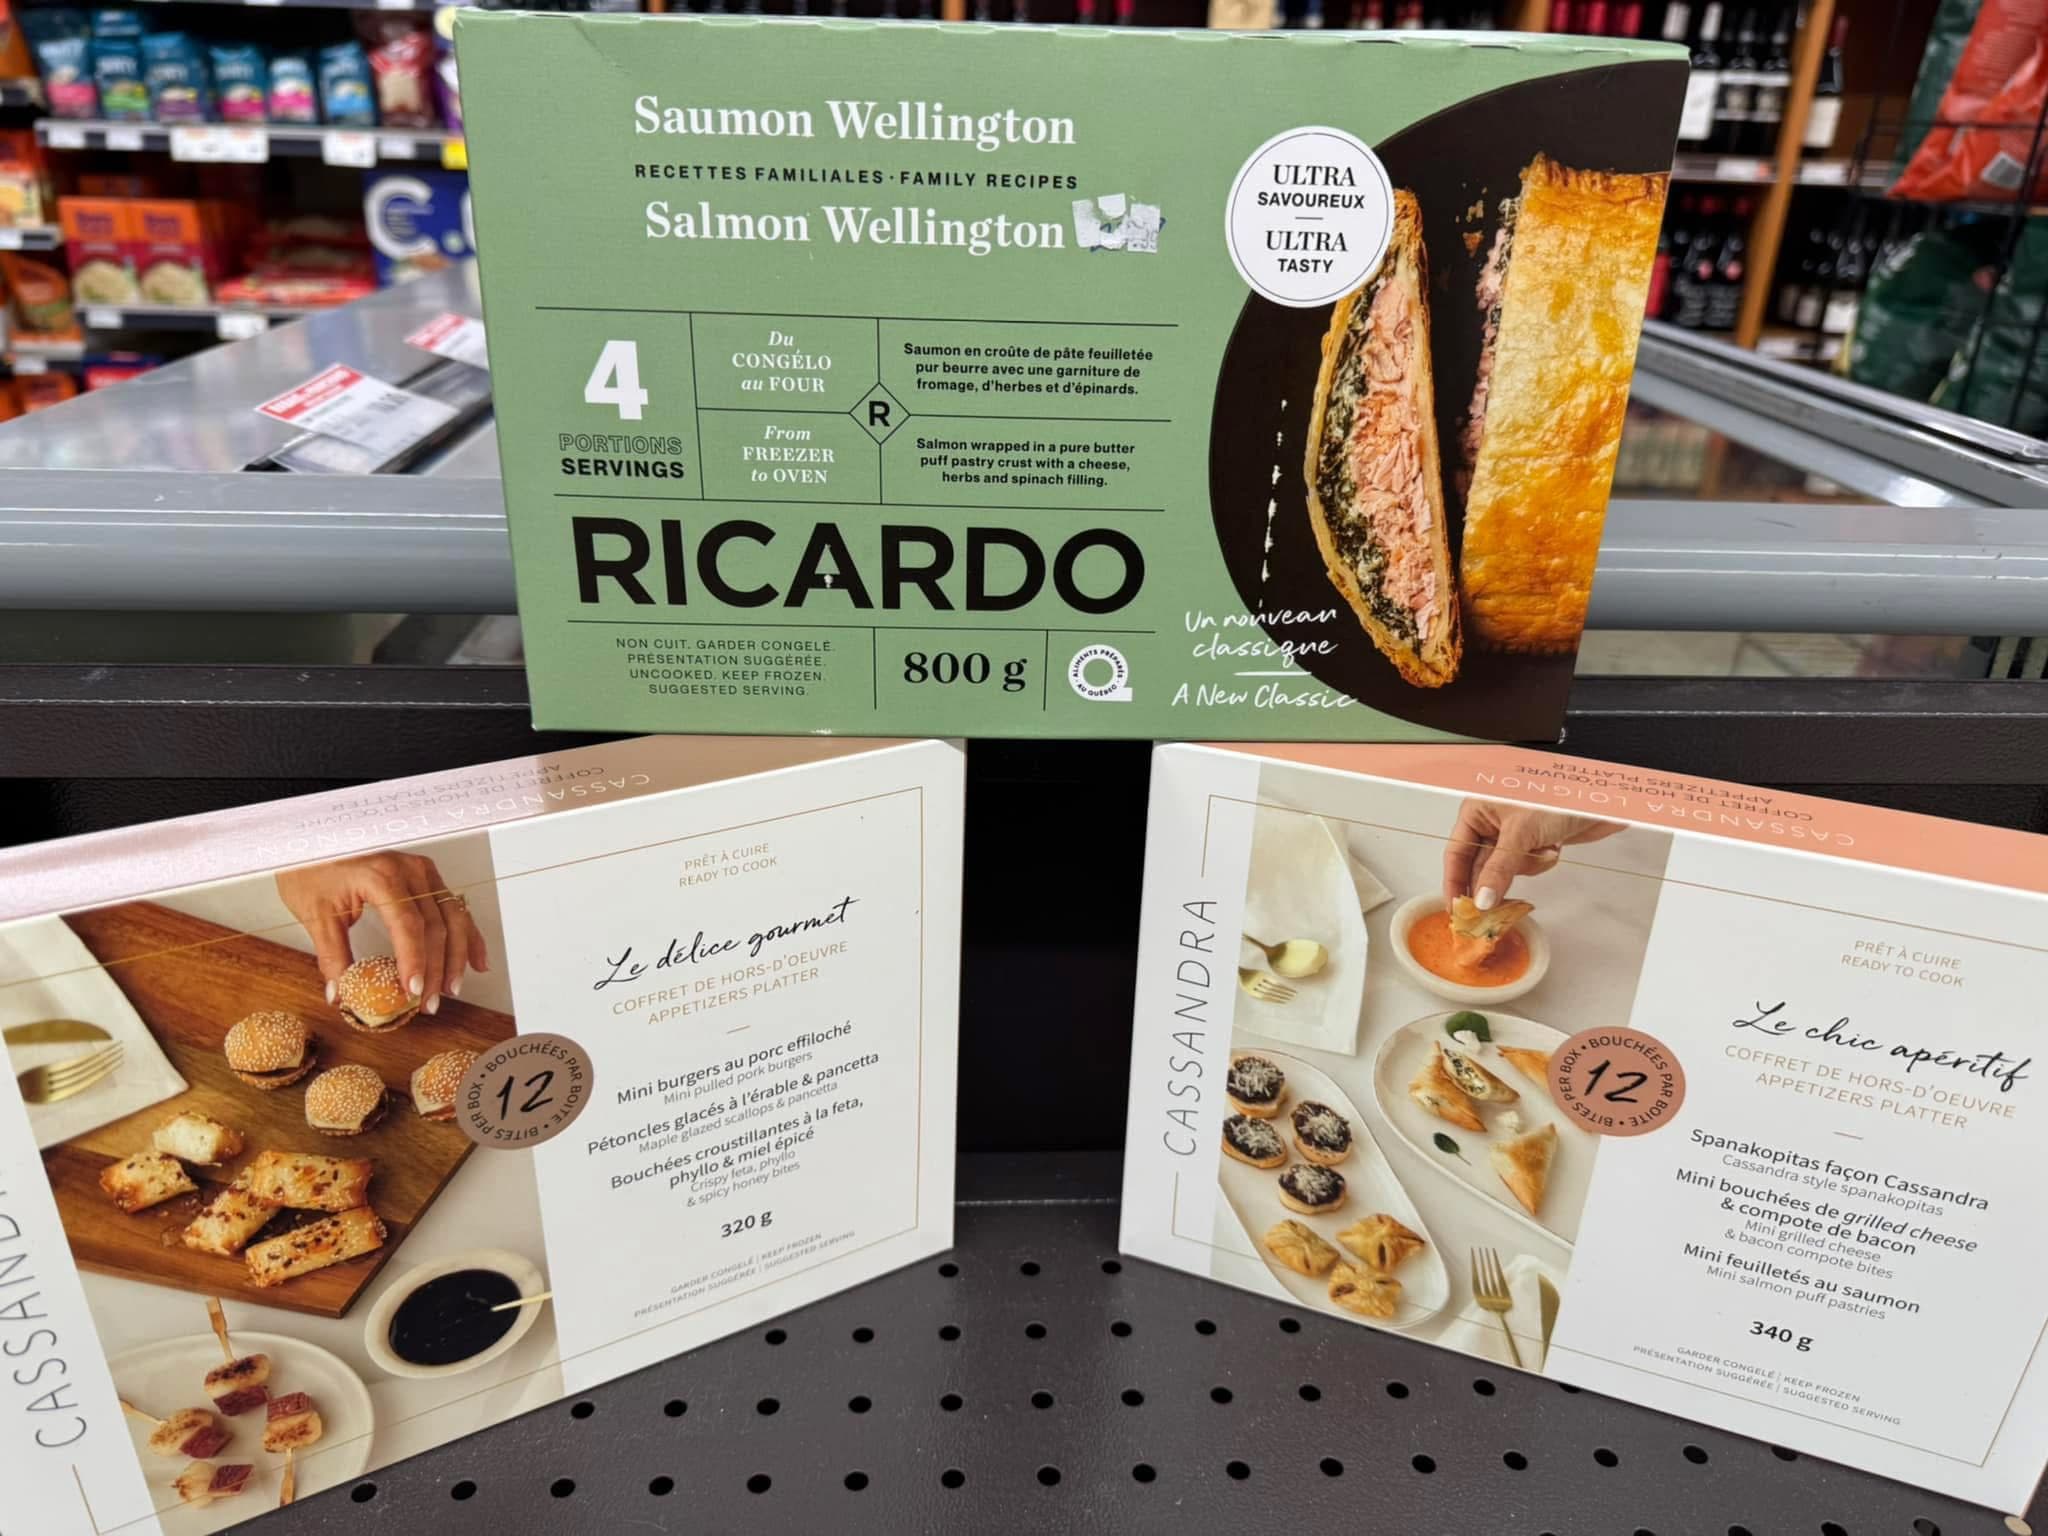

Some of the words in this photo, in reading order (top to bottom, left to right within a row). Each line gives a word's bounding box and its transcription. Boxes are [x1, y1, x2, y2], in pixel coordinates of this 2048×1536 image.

[635, 96, 814, 137] Saumon
[825, 100, 1075, 151] Wellington
[635, 163, 748, 181] RECETTES
[755, 167, 884, 184] FAMILIALES
[899, 171, 976, 187] FAMILY
[986, 173, 1079, 189] RECIPES
[1274, 164, 1356, 186] ULTRA
[1258, 192, 1365, 209] SAVOUREUX
[646, 201, 810, 240] Salmon
[821, 206, 1064, 255] Wellington
[1266, 230, 1348, 251] ULTRA
[1278, 258, 1333, 273] TASTY
[768, 331, 794, 347] Du
[904, 342, 960, 355] Saumon
[964, 347, 980, 356] en
[984, 345, 1029, 357] croûte
[1033, 346, 1050, 358] de
[1054, 347, 1084, 360] pâte
[1088, 347, 1152, 360] feuilletée
[732, 347, 832, 370] CONGÉLO
[916, 363, 938, 374] pur
[942, 361, 988, 374] beurre
[992, 366, 1024, 374] avec
[1028, 367, 1052, 375] une
[1056, 365, 1120, 377] garniture
[1124, 366, 1140, 377] de
[584, 340, 648, 420] 4
[741, 378, 763, 391] au
[770, 377, 825, 392] FOUR
[917, 378, 978, 392] fromage,
[982, 380, 1042, 392] d'herbes
[1046, 382, 1058, 392] et
[1063, 382, 1137, 395] d'épinards.
[868, 401, 890, 426] R
[559, 433, 683, 455] PORTIONS
[764, 426, 811, 440] From
[917, 438, 967, 449] Salmon
[971, 441, 1029, 453] wrapped
[1033, 441, 1044, 451] in
[1048, 444, 1055, 452] a
[1060, 444, 1090, 454] pure
[1094, 442, 1134, 453] butter
[561, 458, 684, 478] SERVINGS
[742, 446, 835, 463] FREEZER
[920, 455, 947, 467] puff
[951, 457, 994, 468] pastry
[998, 458, 1032, 467] crust
[1036, 458, 1063, 468] with
[1067, 460, 1074, 468] a
[1078, 458, 1129, 471] cheese,
[751, 469, 768, 482] to
[772, 469, 828, 483] OVEN
[942, 471, 980, 482] herbs
[983, 473, 1008, 483] and
[1012, 473, 1063, 485] spinach
[1067, 474, 1107, 487] filling.
[572, 515, 1145, 615] RICARDO
[1185, 610, 1216, 632] Un
[1224, 608, 1337, 627] nouveau
[1193, 633, 1338, 668] classique
[903, 651, 990, 684] 800
[1002, 657, 1028, 692] g
[649, 684, 737, 695] SUGGESTED
[743, 686, 809, 696] SERVING.
[1172, 683, 1188, 706] A
[1196, 683, 1248, 706] New
[1254, 682, 1358, 709] Classic
[1476, 772, 1626, 807] LOIGNON
[1648, 802, 1854, 846] CASSANDRA
[679, 870, 719, 888] READY
[723, 864, 739, 877] TO
[742, 855, 778, 874] COOK
[684, 853, 717, 871] PRÊT
[721, 849, 729, 863] À
[732, 842, 769, 860] CUIRE
[594, 947, 648, 990] Le
[656, 931, 741, 970] délice
[748, 896, 861, 957] gourmet
[1854, 940, 1892, 957] PRÊT
[1898, 943, 1908, 959] À
[1912, 951, 1962, 970] CUIRE
[613, 984, 688, 1015] COFFRET
[694, 977, 715, 992] DE
[721, 941, 848, 984] HORS-D'OEUVRE
[1841, 954, 1890, 973] READY
[1896, 963, 1914, 977] TO
[1919, 969, 1964, 988] COOK
[648, 987, 748, 1025] APPETIZERS
[754, 967, 819, 996] PLATTER
[1164, 901, 1217, 1156] CASSANDRA
[617, 1082, 652, 1104] Mini
[658, 1065, 720, 1092] burgers
[724, 1058, 743, 1071] au
[749, 1045, 783, 1067] porc
[787, 1020, 851, 1051] effiloché
[1732, 1000, 1796, 1035] Le
[1805, 1017, 1884, 1050] chic
[1890, 1045, 2032, 1091] apéritif
[496, 1071, 554, 1120] 12
[1584, 1060, 1648, 1103] 12
[1725, 1045, 1811, 1072] COFFRET
[1816, 1064, 1842, 1080] DE
[1848, 1072, 2015, 1117] HORS-D'OEUVRE
[588, 1121, 670, 1154] Pétoncles
[674, 1102, 724, 1131] glacés
[729, 1096, 737, 1110] à
[742, 1079, 798, 1105] l'érable
[801, 1073, 812, 1086] &
[817, 1054, 878, 1084] pancetta
[1755, 1073, 1874, 1107] APPETIZERS
[1880, 1099, 1967, 1128] PLATTER
[611, 1154, 691, 1188] Bouchées
[695, 1118, 799, 1160] croustillantes
[803, 1114, 811, 1124] à
[816, 1108, 828, 1120] la
[832, 1098, 863, 1114] feta,
[670, 1162, 718, 1188] phyllo
[722, 1155, 733, 1168] &
[738, 1141, 770, 1163] miel
[775, 1129, 814, 1151] épicé
[1691, 1129, 1819, 1170] Spanakopitas
[1825, 1160, 1878, 1184] façon
[1884, 1175, 1988, 1210] Cassandra
[720, 1215, 755, 1238] 320
[760, 1210, 773, 1227] g
[1676, 1168, 1715, 1188] Mini
[1719, 1178, 1810, 1211] bouchées
[1815, 1203, 1839, 1218] de
[1841, 1212, 1908, 1234] grilled
[1909, 1227, 1977, 1251] cheese
[1721, 1197, 1734, 1210] &
[1739, 1204, 1822, 1232] compote
[1827, 1224, 1851, 1239] de
[1856, 1229, 1915, 1255] bacon
[1684, 1243, 1722, 1262] Mini
[1726, 1253, 1809, 1285] feuilletés
[1814, 1279, 1837, 1292] au
[1842, 1286, 1919, 1313] saumon
[1707, 1265, 1736, 1280] Mini
[1739, 1275, 1792, 1295] salmon
[1795, 1290, 1826, 1303] puff
[1827, 1298, 1885, 1319] pastries
[1749, 1321, 1792, 1342] 340
[1797, 1336, 1814, 1352] g
